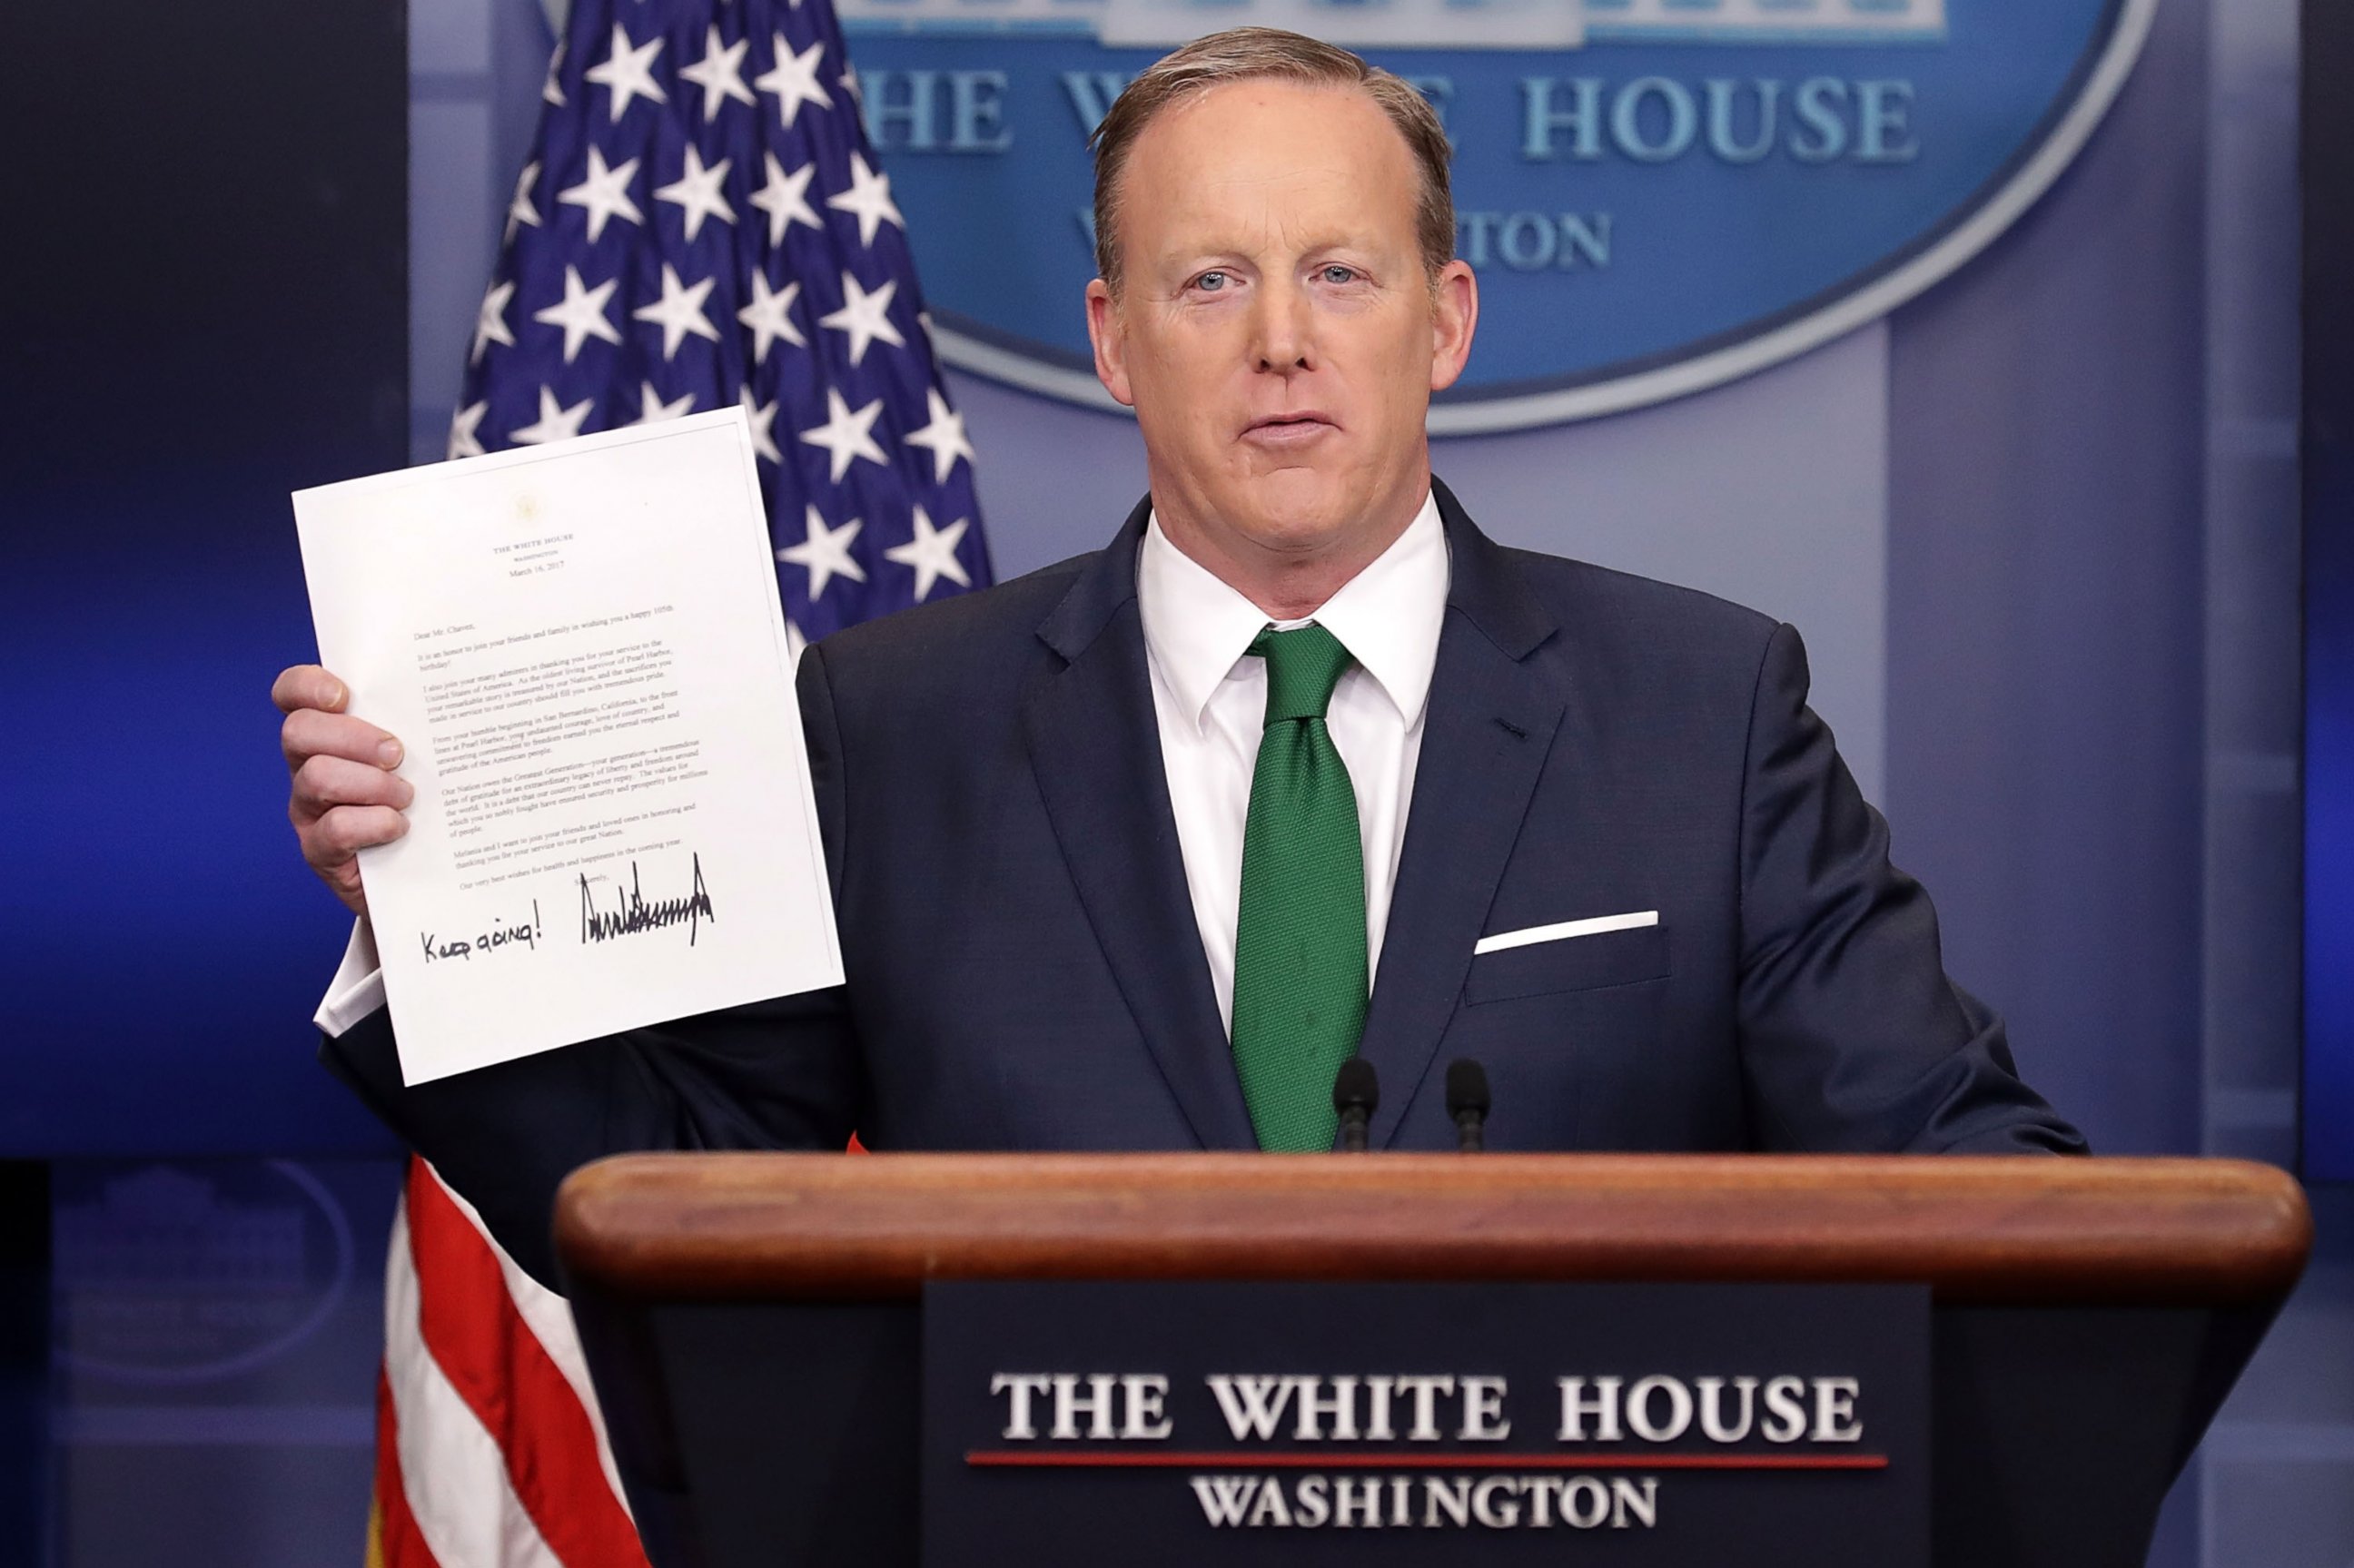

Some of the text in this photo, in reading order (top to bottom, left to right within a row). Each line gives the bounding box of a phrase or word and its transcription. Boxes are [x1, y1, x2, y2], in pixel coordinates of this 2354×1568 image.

[1520, 76, 1919, 163] HOUSE
[991, 1374, 1864, 1443] THE WHITE HOUSE
[1192, 1476, 1658, 1528] WASHINGTON
